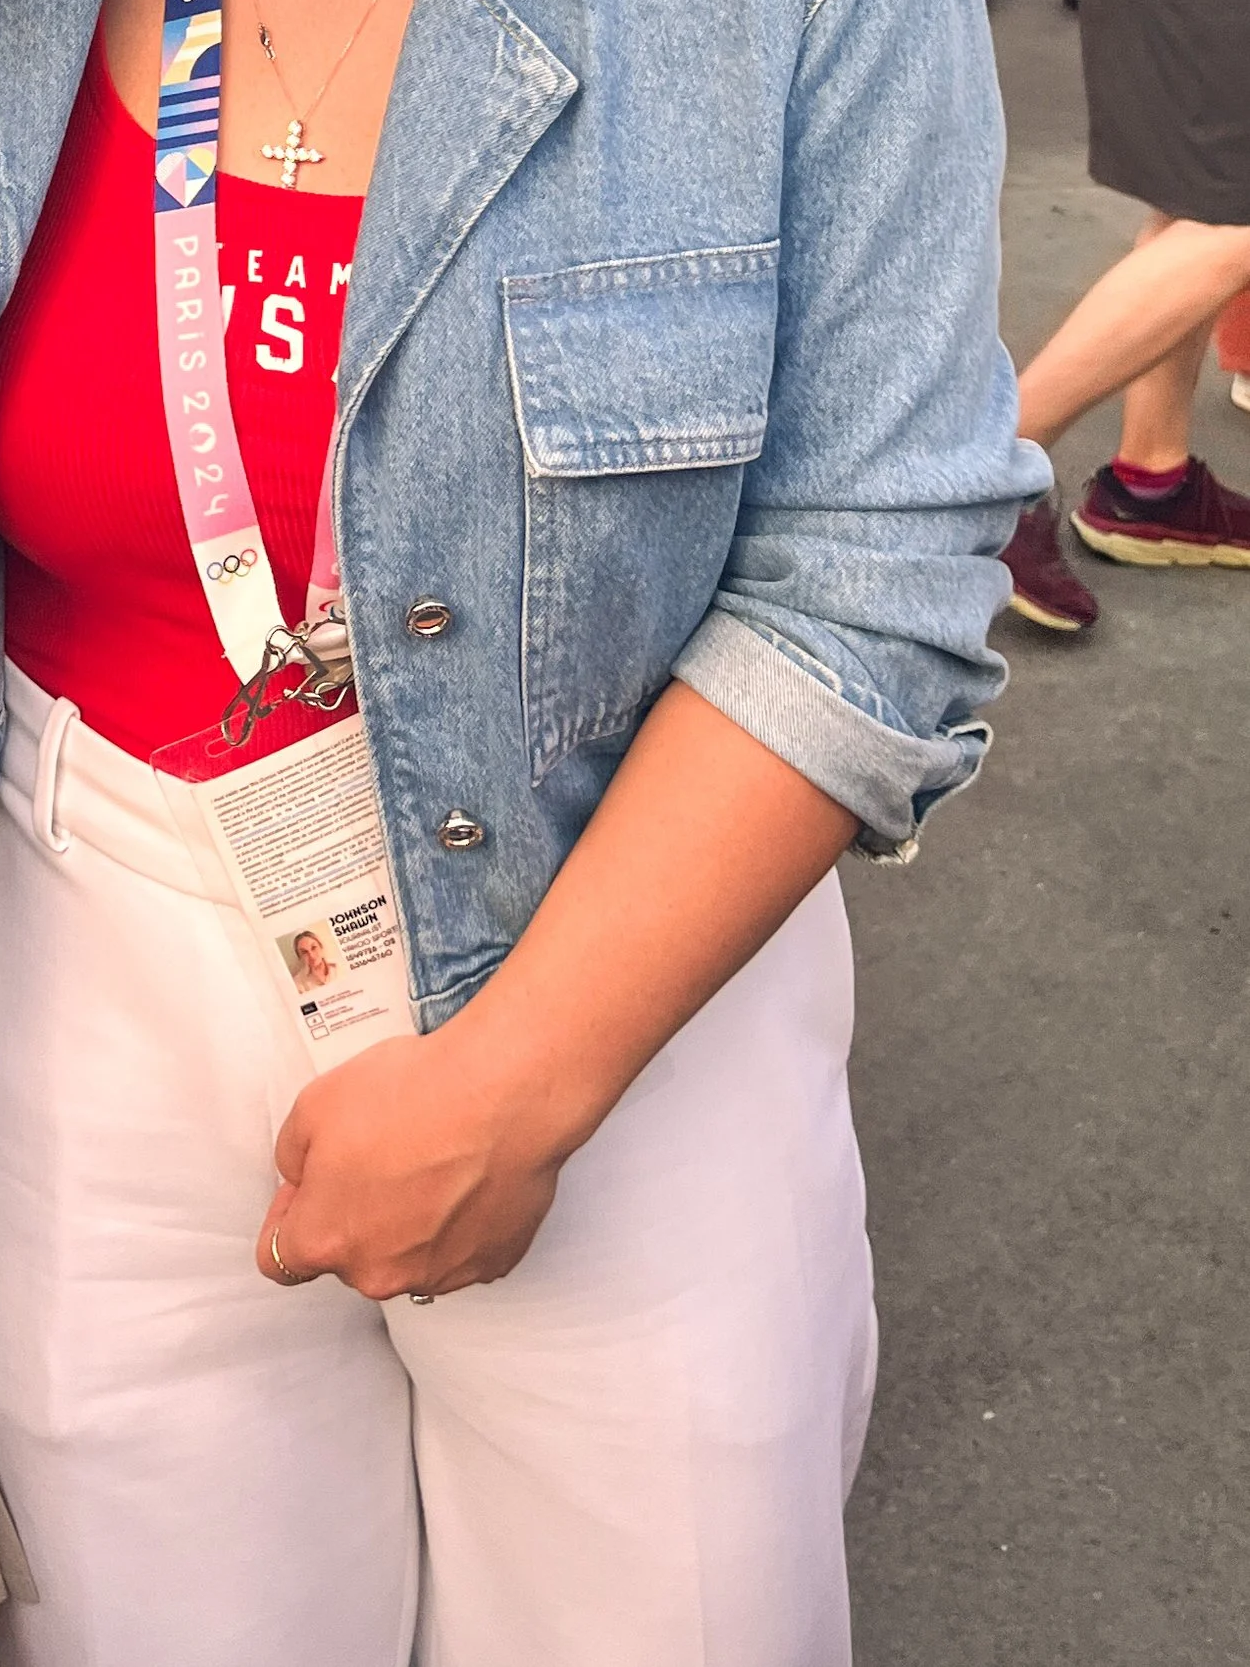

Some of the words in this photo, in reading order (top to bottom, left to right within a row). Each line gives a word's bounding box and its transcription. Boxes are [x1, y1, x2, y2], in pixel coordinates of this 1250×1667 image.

[215, 242, 353, 295] EAM
[173, 235, 207, 372] PARIS
[182, 390, 229, 517] 2024
[329, 894, 387, 927] JOHNSON
[334, 912, 378, 937] SHAWN
